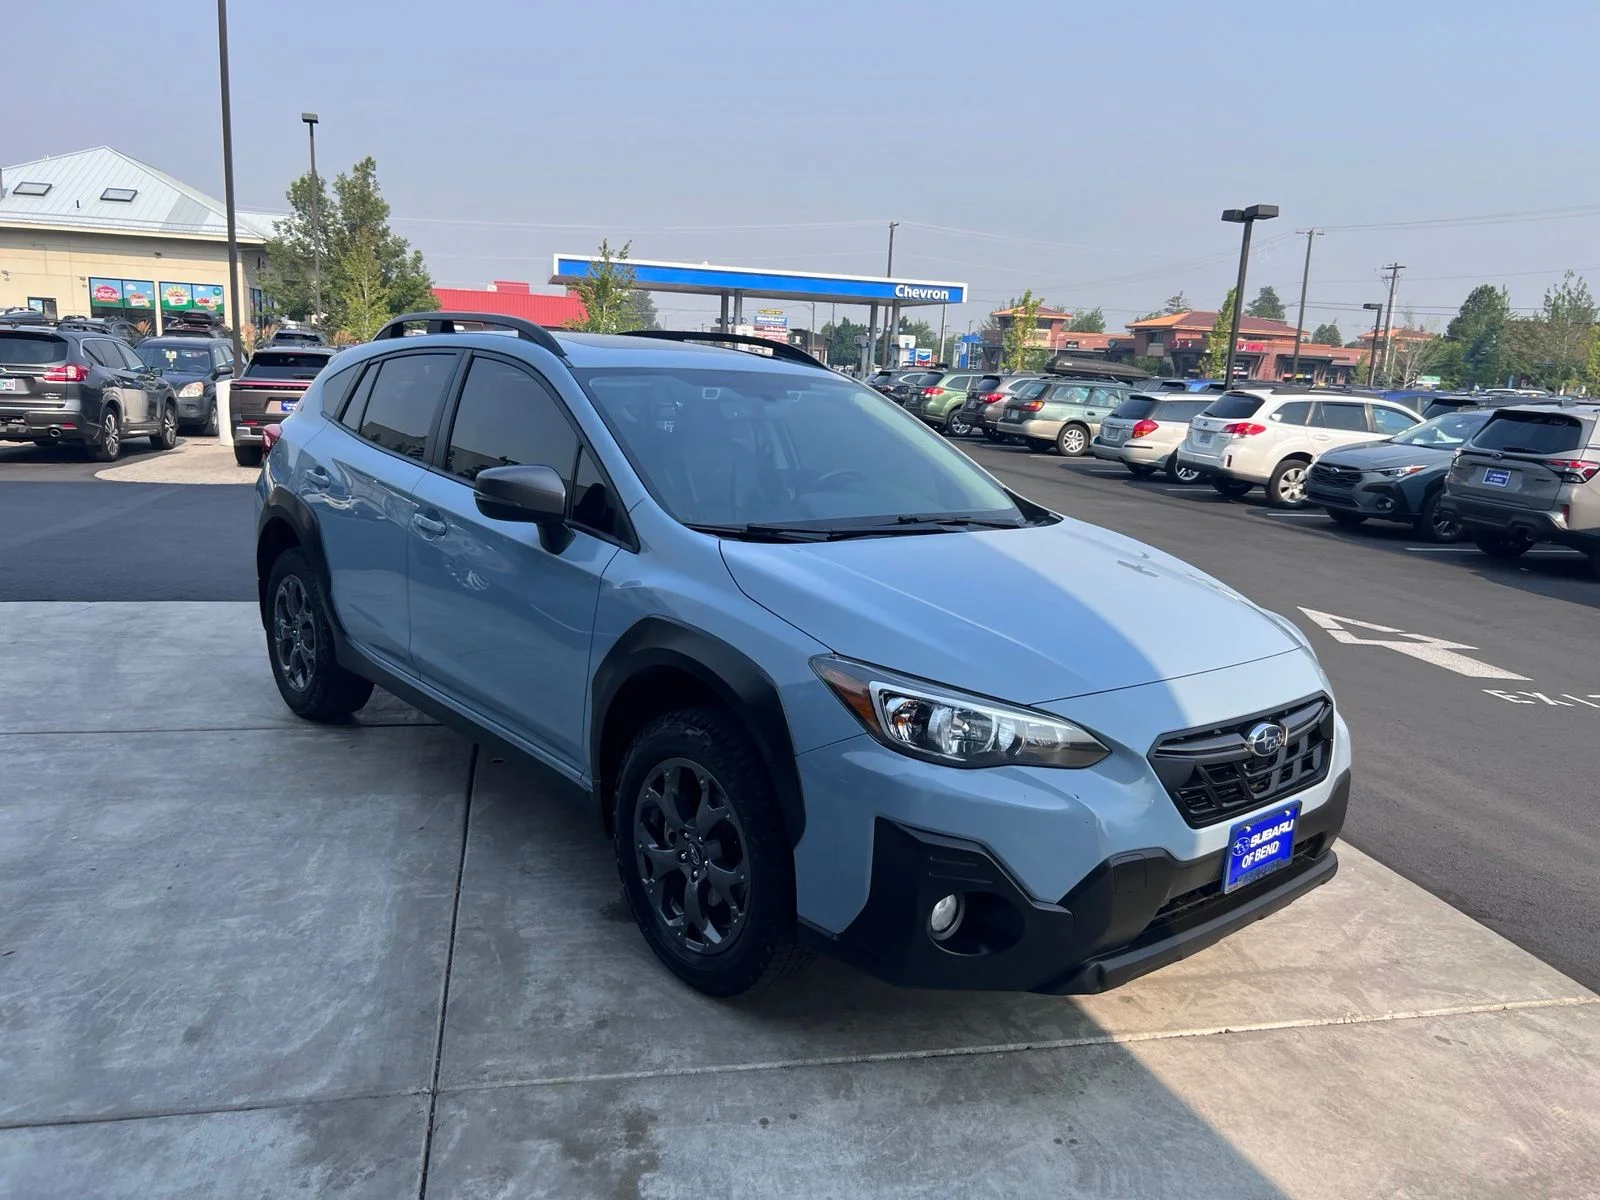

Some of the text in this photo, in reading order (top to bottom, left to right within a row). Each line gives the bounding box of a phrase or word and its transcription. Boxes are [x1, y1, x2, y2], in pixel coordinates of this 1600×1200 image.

[895, 285, 949, 300] Chevron
[1481, 689, 1600, 708] EXI
[1250, 819, 1294, 848] SUBARU
[1241, 841, 1279, 868] OF BEND
